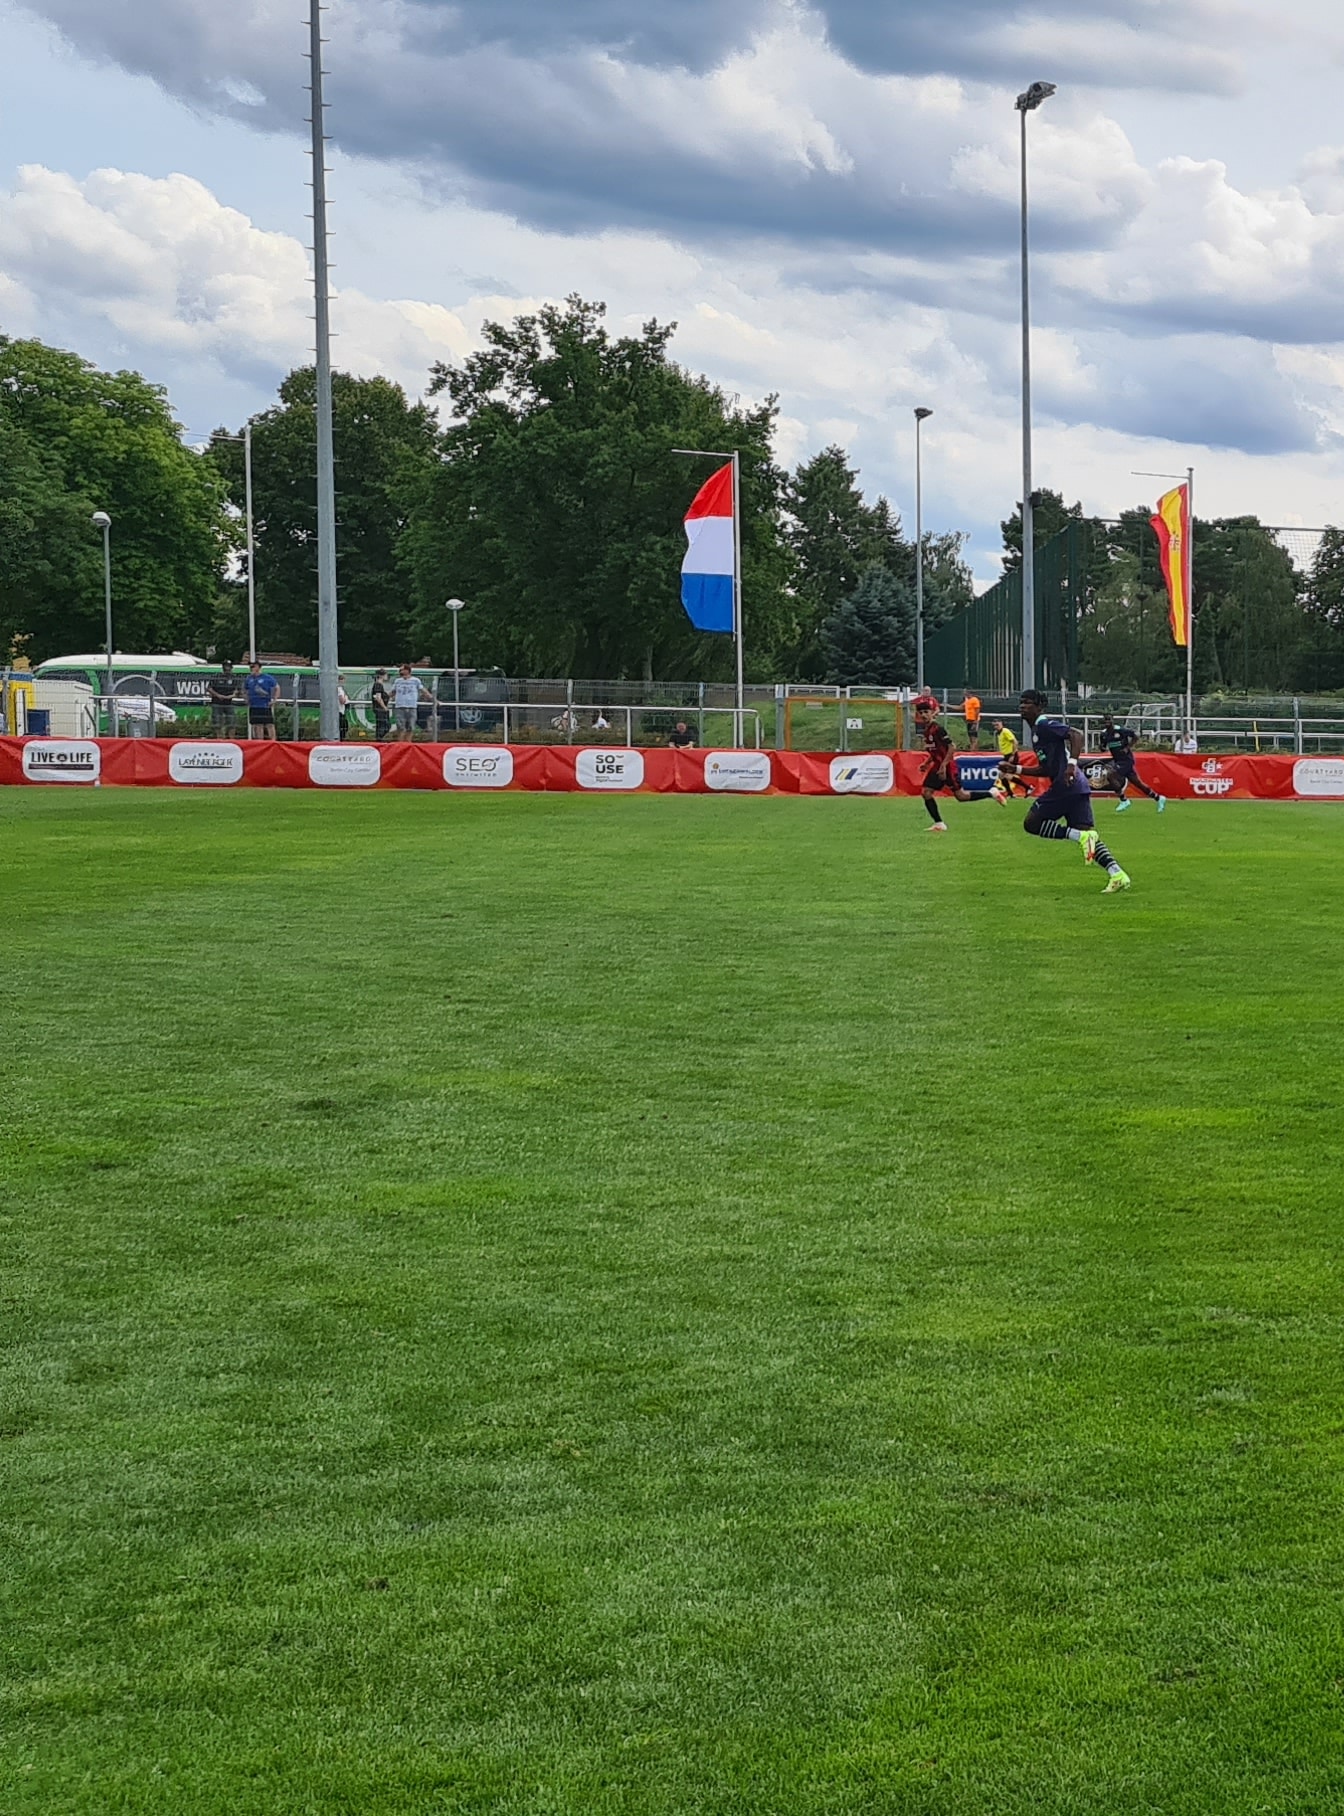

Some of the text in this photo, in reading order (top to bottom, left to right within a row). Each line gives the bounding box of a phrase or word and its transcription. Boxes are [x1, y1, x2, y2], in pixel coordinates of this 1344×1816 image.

[31, 752, 92, 762] LIVE LIFE
[595, 754, 616, 764] SO
[455, 757, 497, 772] SEO
[595, 764, 624, 774] USE
[960, 767, 1000, 780] HYLO
[1193, 781, 1230, 795] CUP
